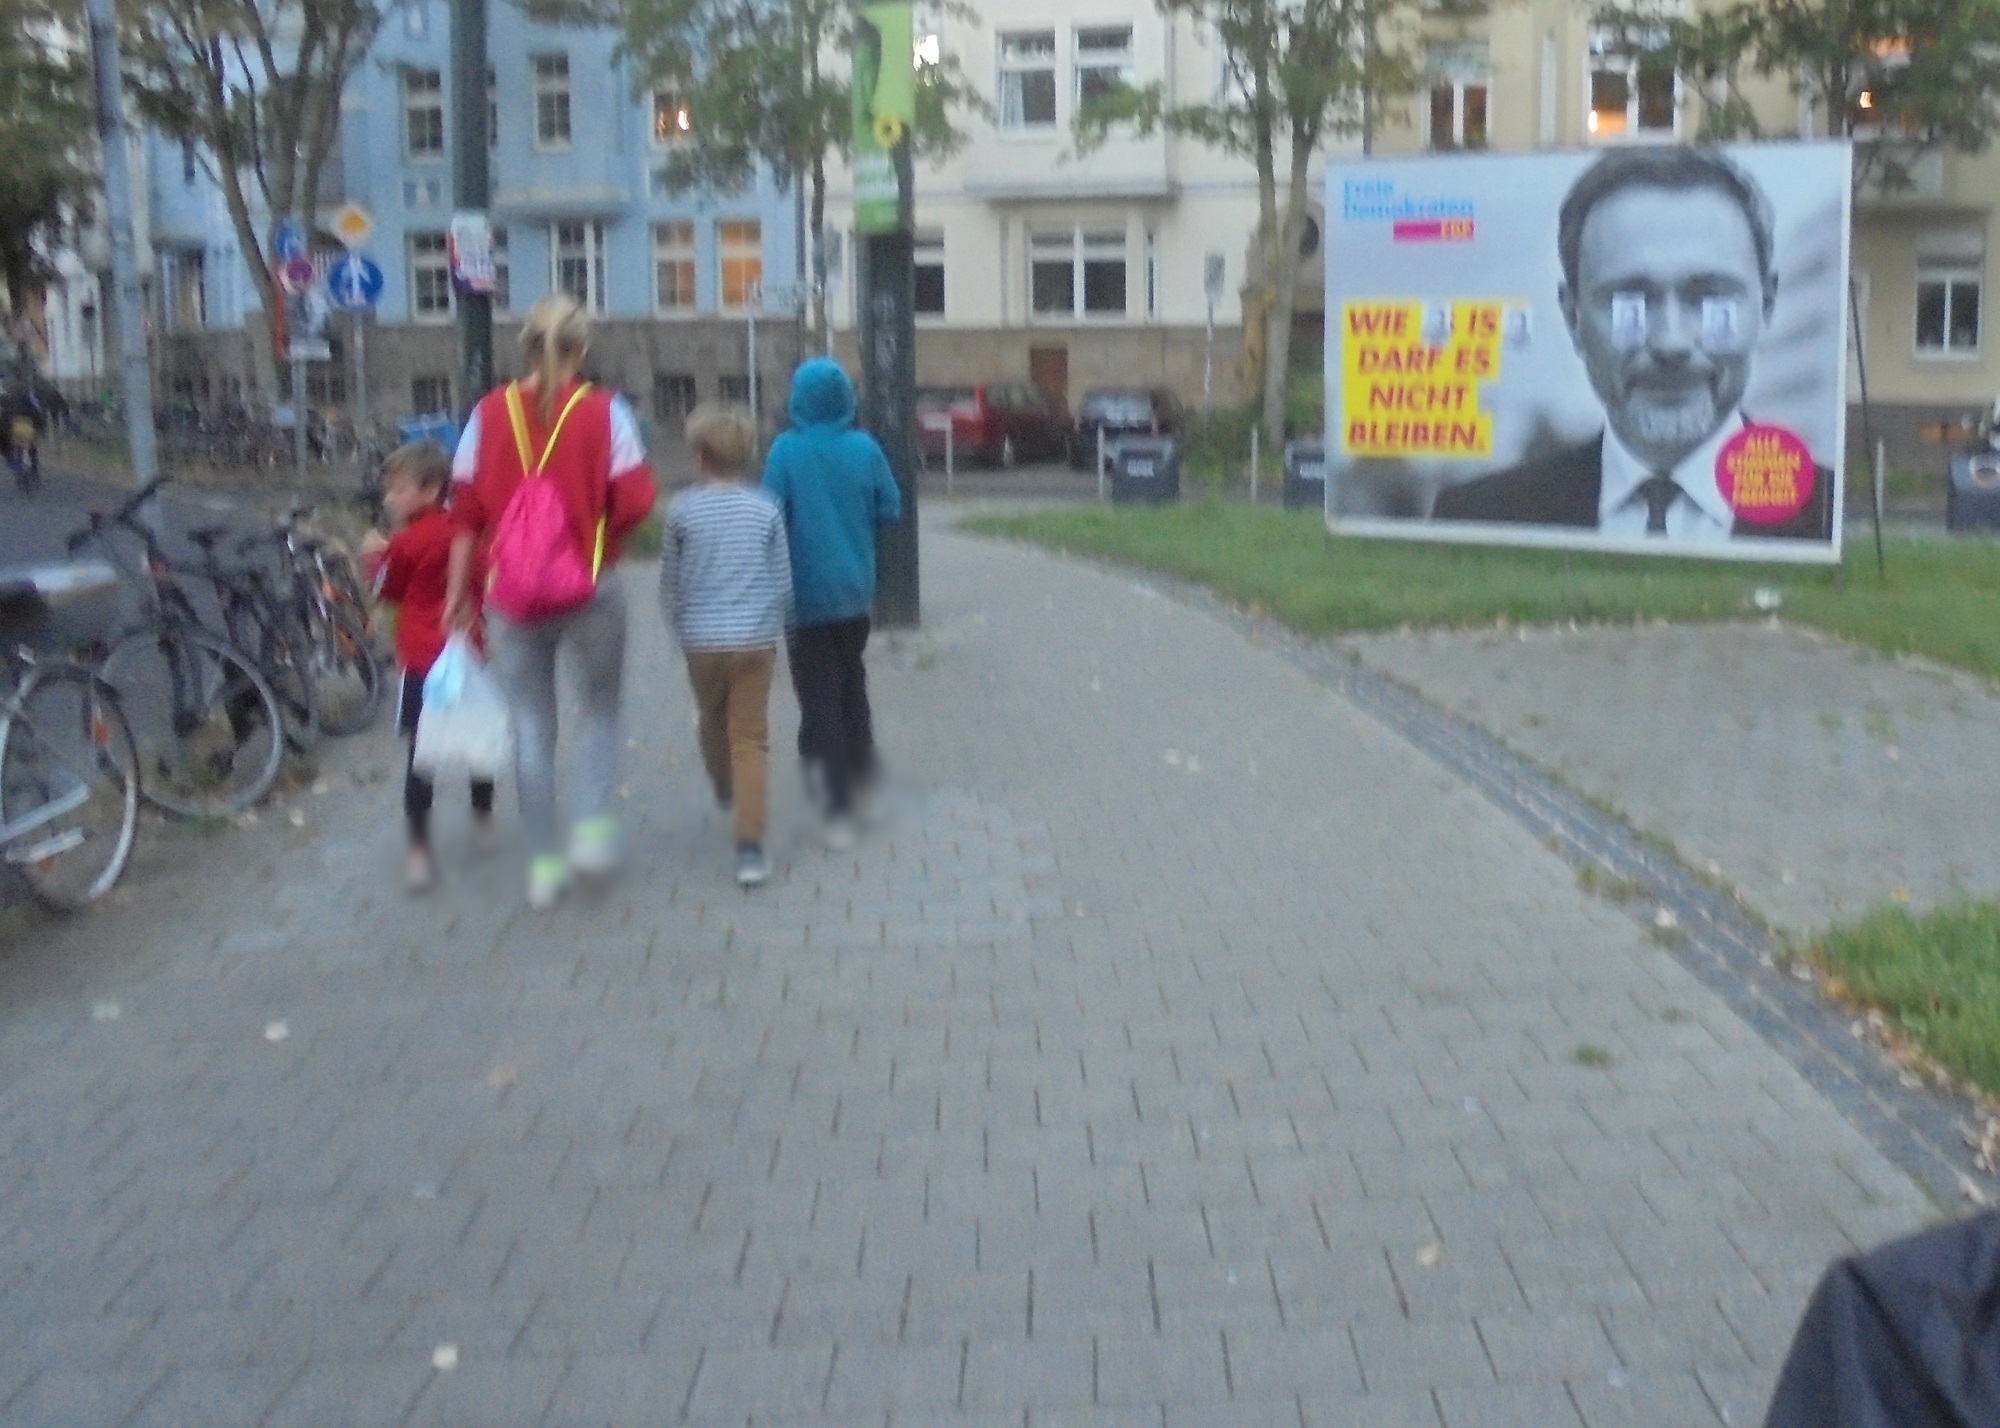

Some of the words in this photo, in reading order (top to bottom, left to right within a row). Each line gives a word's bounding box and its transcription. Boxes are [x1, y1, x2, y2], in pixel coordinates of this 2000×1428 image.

[1350, 305, 1408, 336] WIE
[1468, 304, 1503, 338] IS
[1358, 345, 1445, 374] DARF
[1455, 345, 1492, 376] ES
[1369, 382, 1469, 411] NICHT
[1349, 420, 1486, 451] BLEIBEN.
